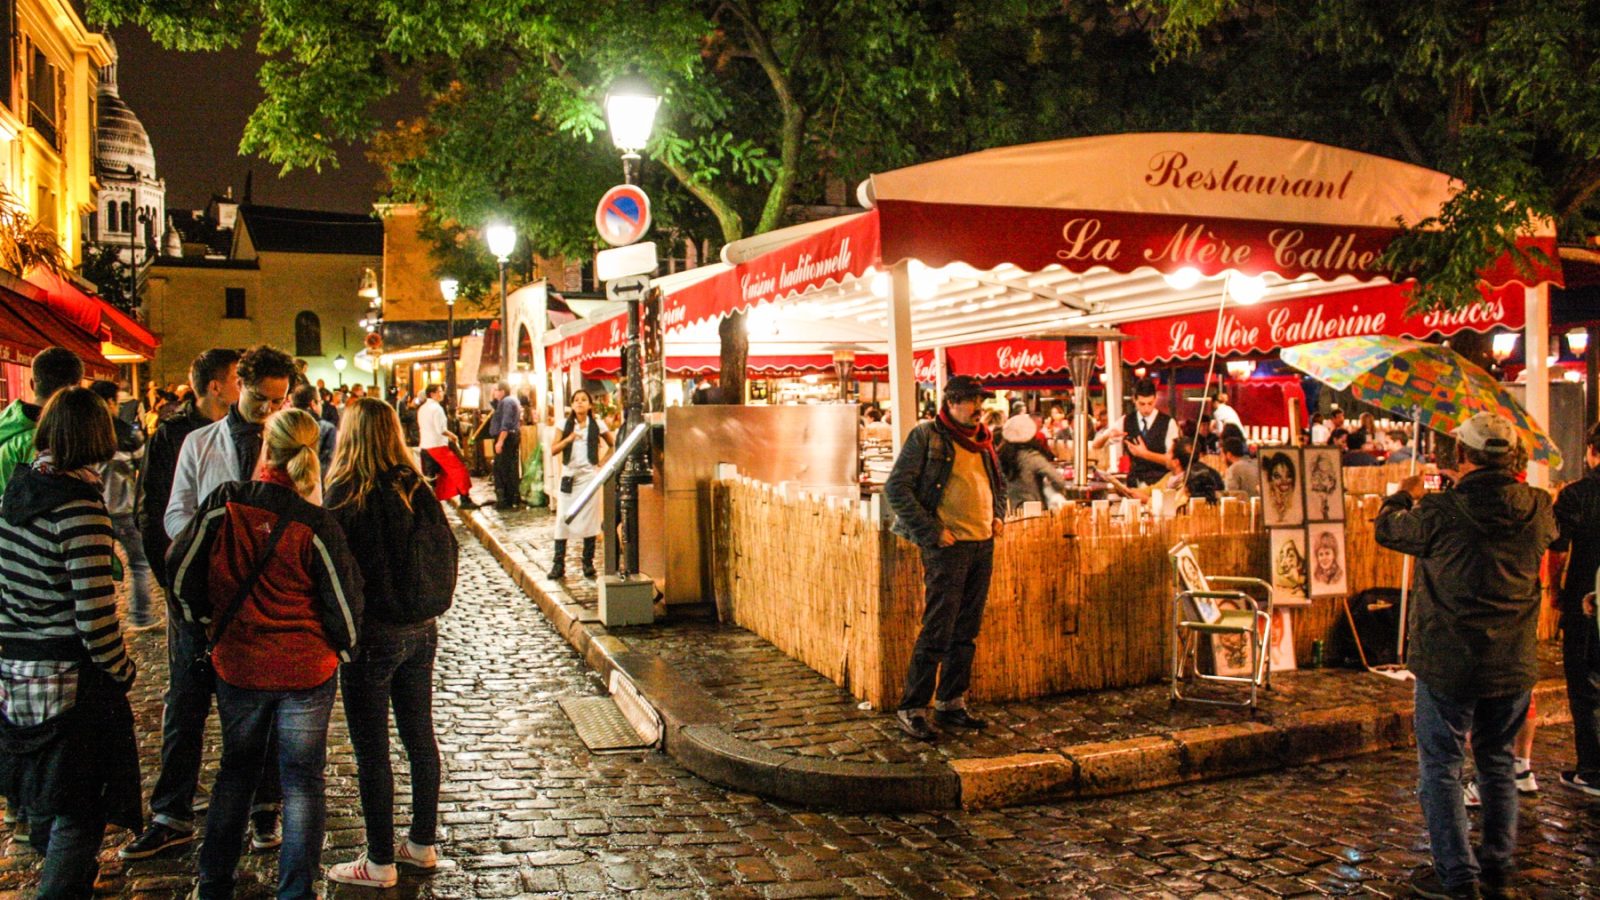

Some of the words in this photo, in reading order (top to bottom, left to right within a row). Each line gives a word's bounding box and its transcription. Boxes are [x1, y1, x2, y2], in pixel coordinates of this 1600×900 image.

[1145, 151, 1354, 200] Restaurant
[1056, 217, 1122, 262] La
[1143, 222, 1252, 265] Mère
[1168, 320, 1196, 353] La
[1204, 314, 1260, 350] Mère
[1267, 304, 1387, 343] Catherine
[912, 357, 937, 381] Caf
[996, 346, 1045, 374] Crêpes
